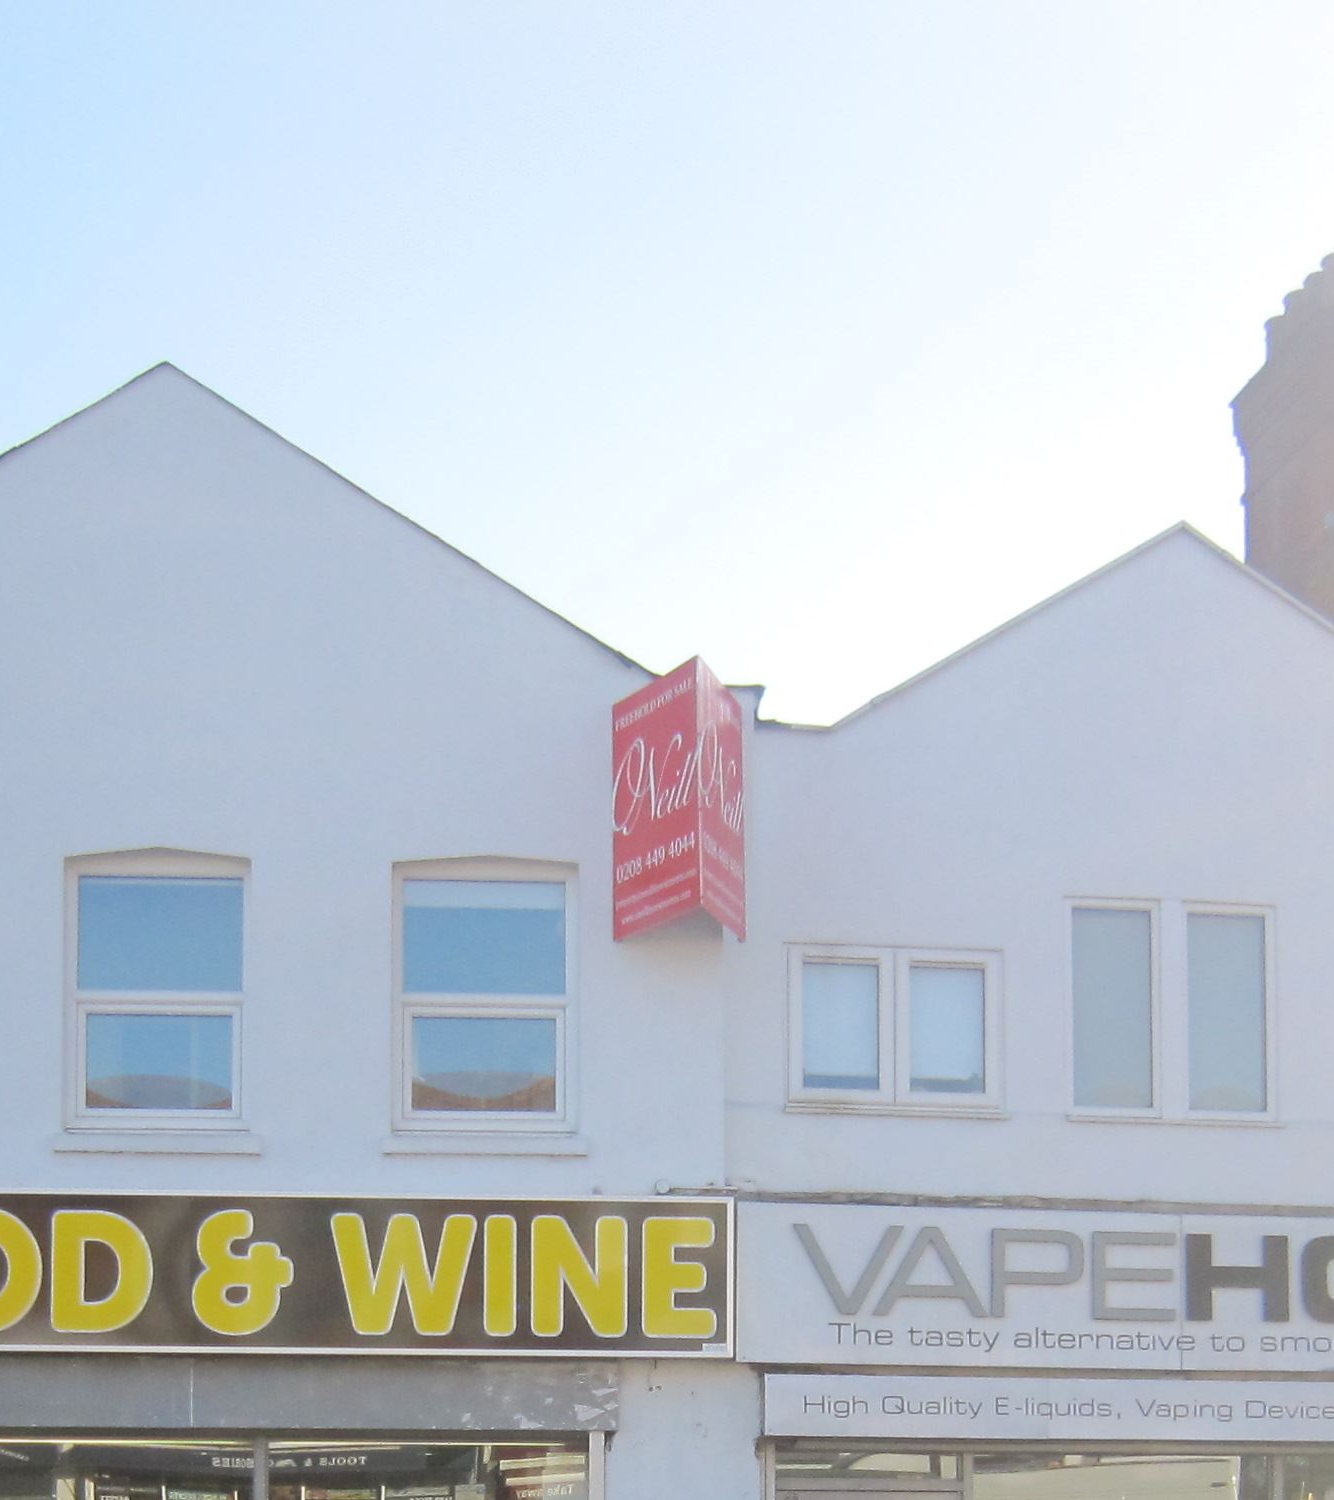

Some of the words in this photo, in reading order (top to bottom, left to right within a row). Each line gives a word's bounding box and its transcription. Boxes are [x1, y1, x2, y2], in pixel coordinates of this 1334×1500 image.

[646, 846, 666, 870] 449
[668, 831, 696, 859] 4044
[192, 1208, 294, 1336] &
[330, 1213, 718, 1338] WINE
[828, 1322, 894, 1346] The
[907, 1326, 1001, 1353] tasty
[1013, 1326, 1196, 1352] alternative
[1211, 1333, 1246, 1353] to
[802, 1395, 869, 1419] High
[881, 1395, 984, 1420] Quality
[1135, 1398, 1233, 1422] Vaping
